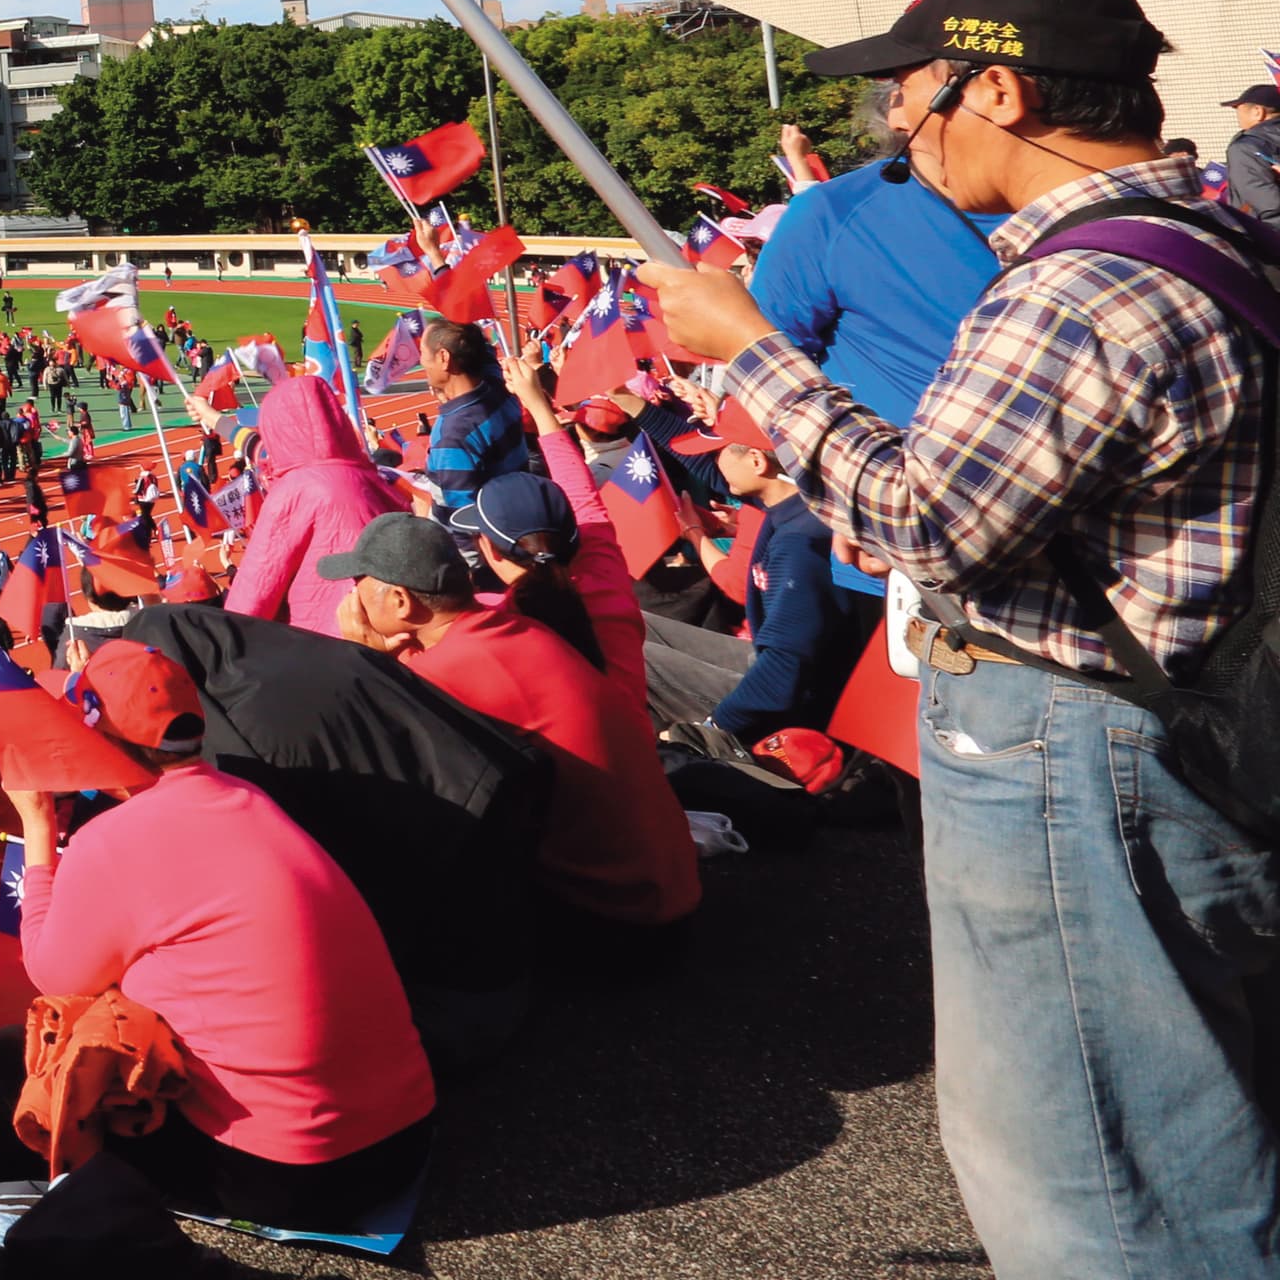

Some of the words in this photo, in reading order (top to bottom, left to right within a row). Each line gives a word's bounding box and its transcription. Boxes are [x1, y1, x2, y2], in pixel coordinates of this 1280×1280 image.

[943, 16, 1020, 38] 台灣安全
[944, 34, 1024, 57] 人民有錢
